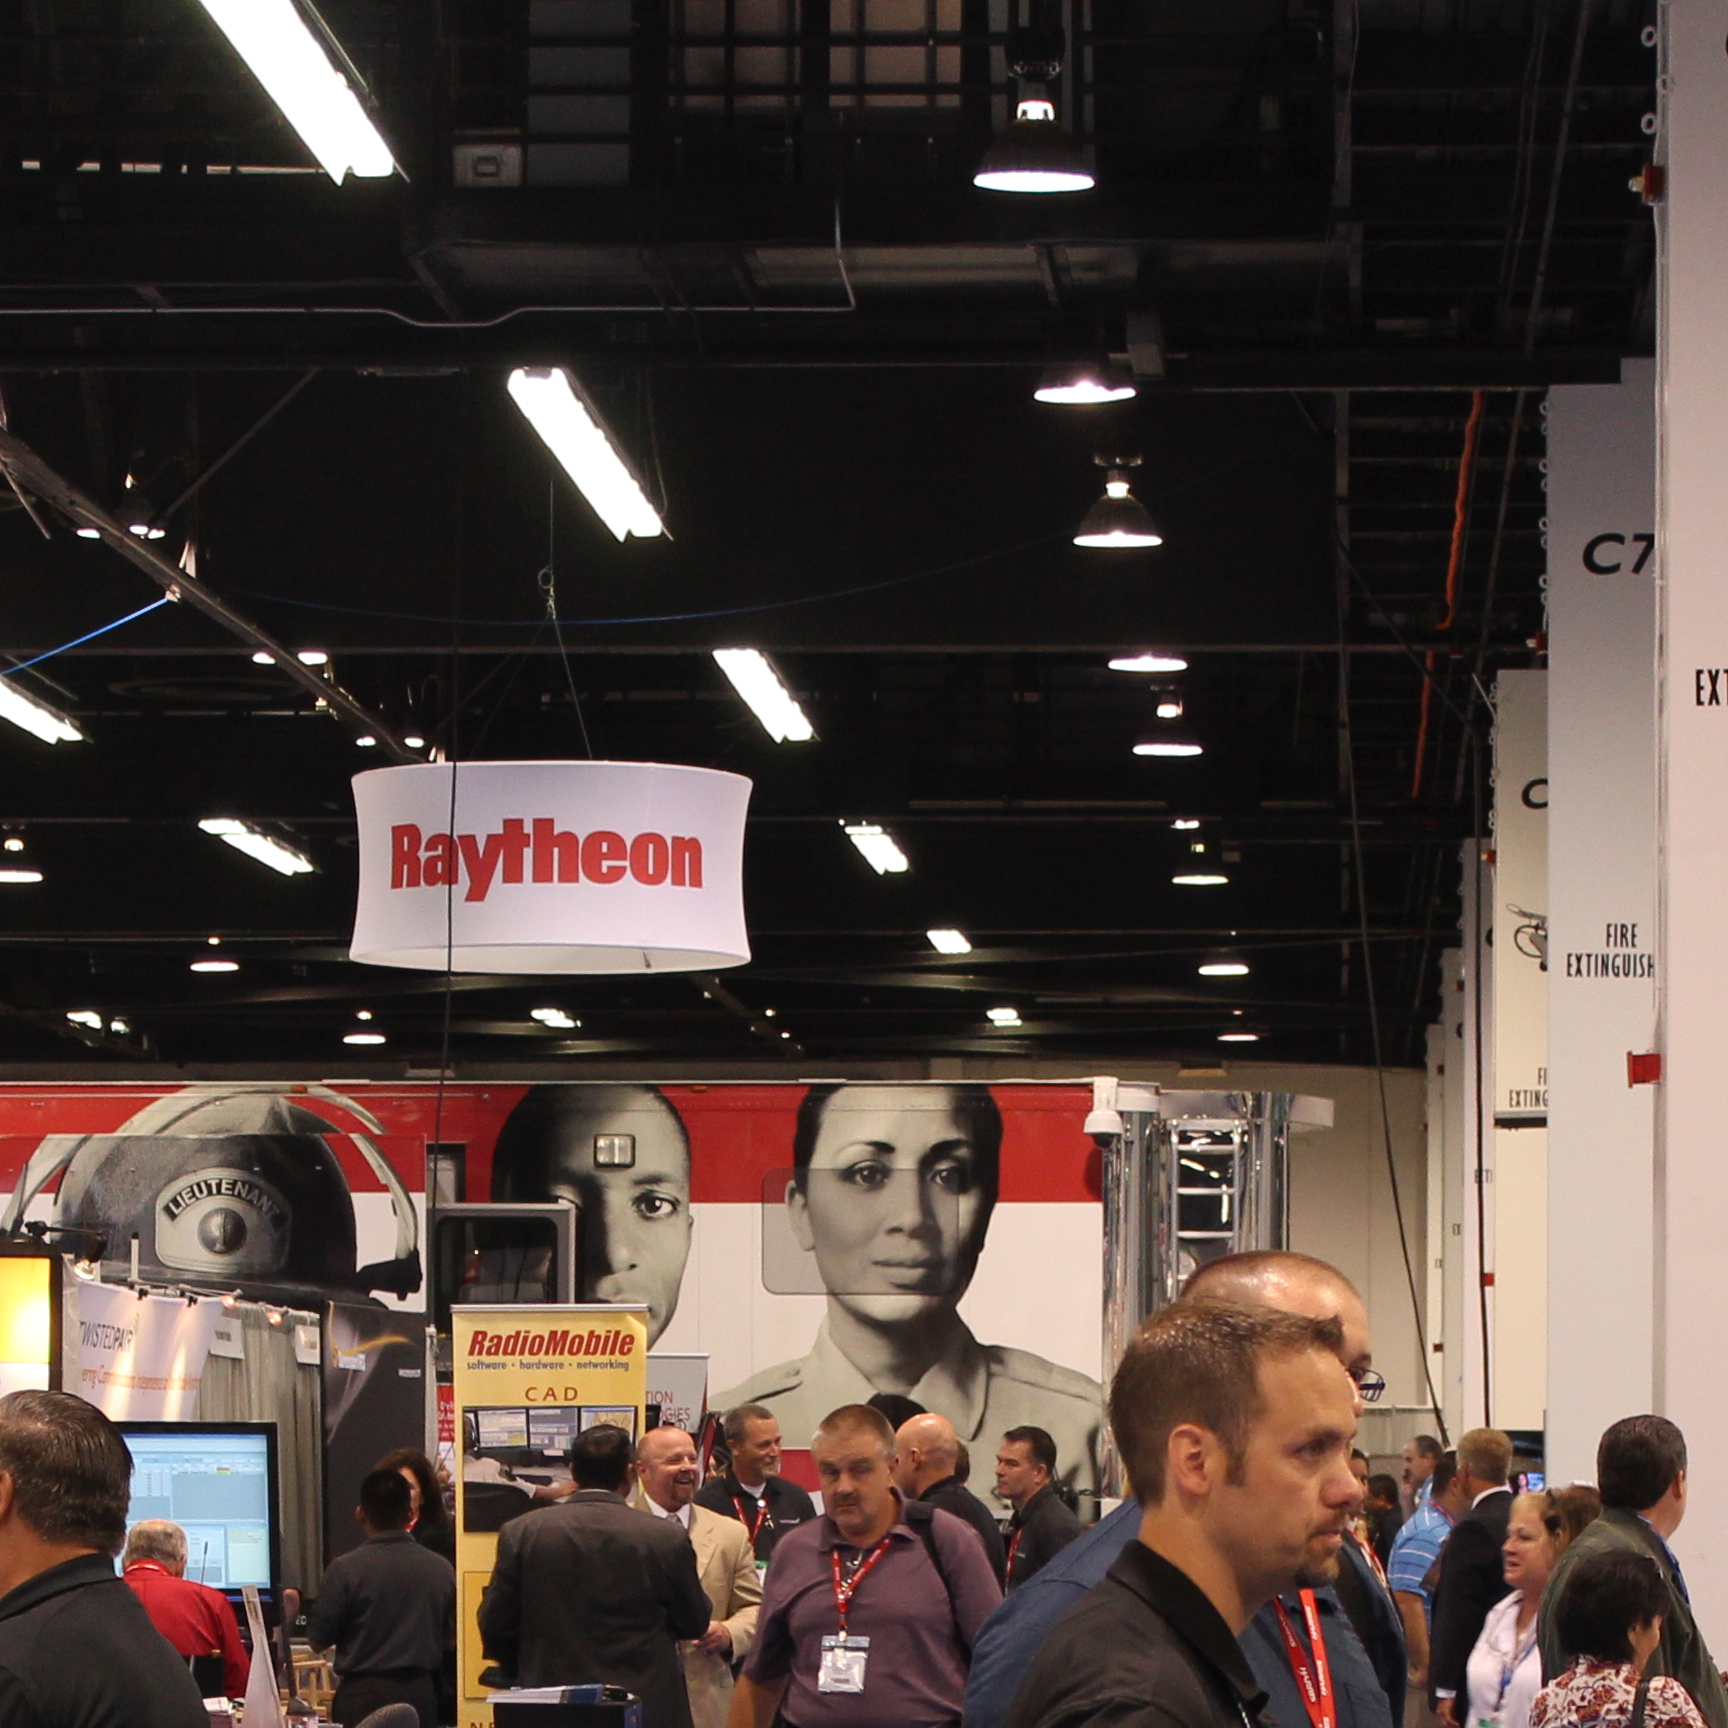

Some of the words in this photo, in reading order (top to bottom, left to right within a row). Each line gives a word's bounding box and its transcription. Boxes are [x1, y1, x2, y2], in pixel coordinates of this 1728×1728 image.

[389, 817, 703, 903] Raytheon
[1605, 922, 1638, 948] FIRE
[168, 1178, 281, 1219] LIEUTENANT
[467, 1329, 636, 1358] RadioMobile
[467, 1358, 507, 1370] software
[519, 1358, 565, 1370] hardware
[576, 1358, 630, 1372] networking
[525, 1386, 579, 1402] CAD
